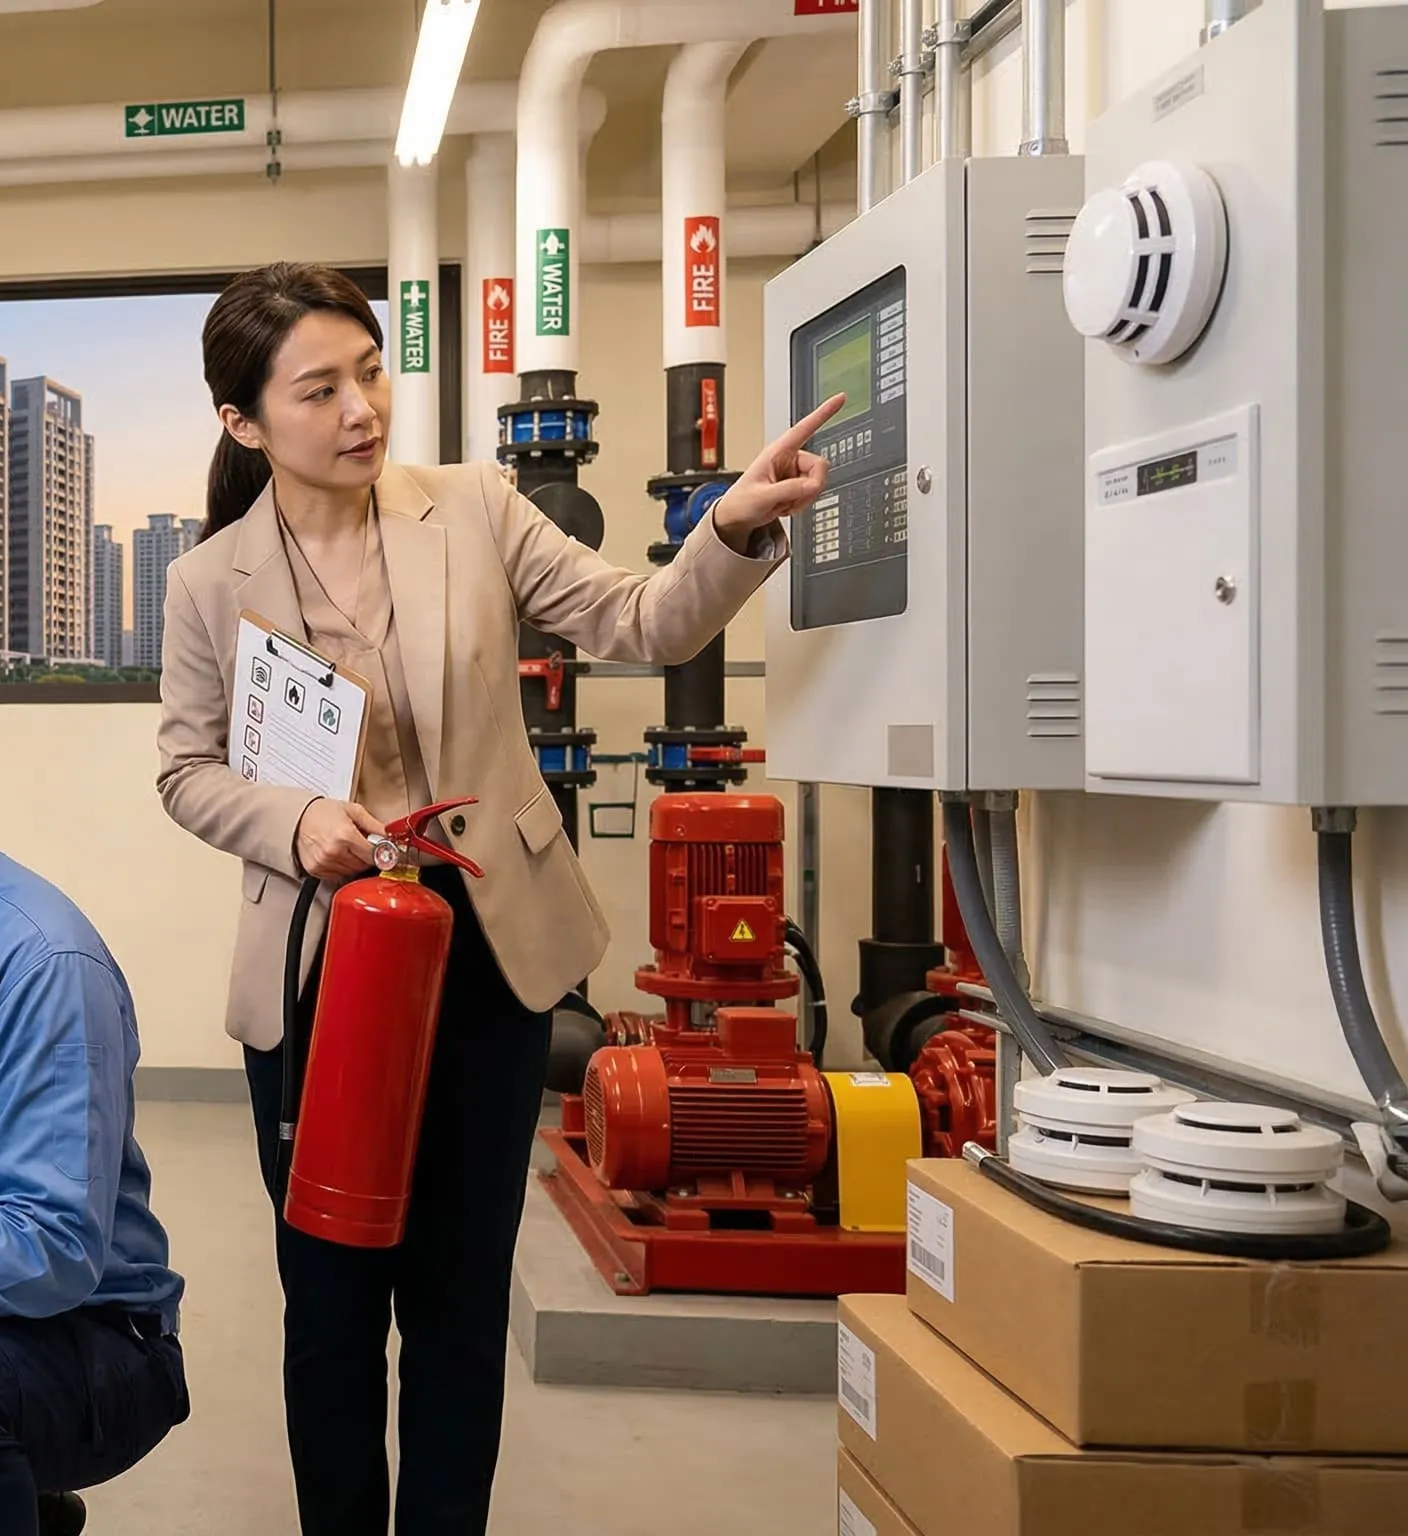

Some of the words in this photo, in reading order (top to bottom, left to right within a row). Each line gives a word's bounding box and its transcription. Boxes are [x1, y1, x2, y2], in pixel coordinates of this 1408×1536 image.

[162, 104, 239, 129] WATER
[542, 263, 563, 330] WATER
[692, 264, 714, 311] FIRE
[405, 311, 424, 368] WATER
[489, 319, 508, 361] FIRE
